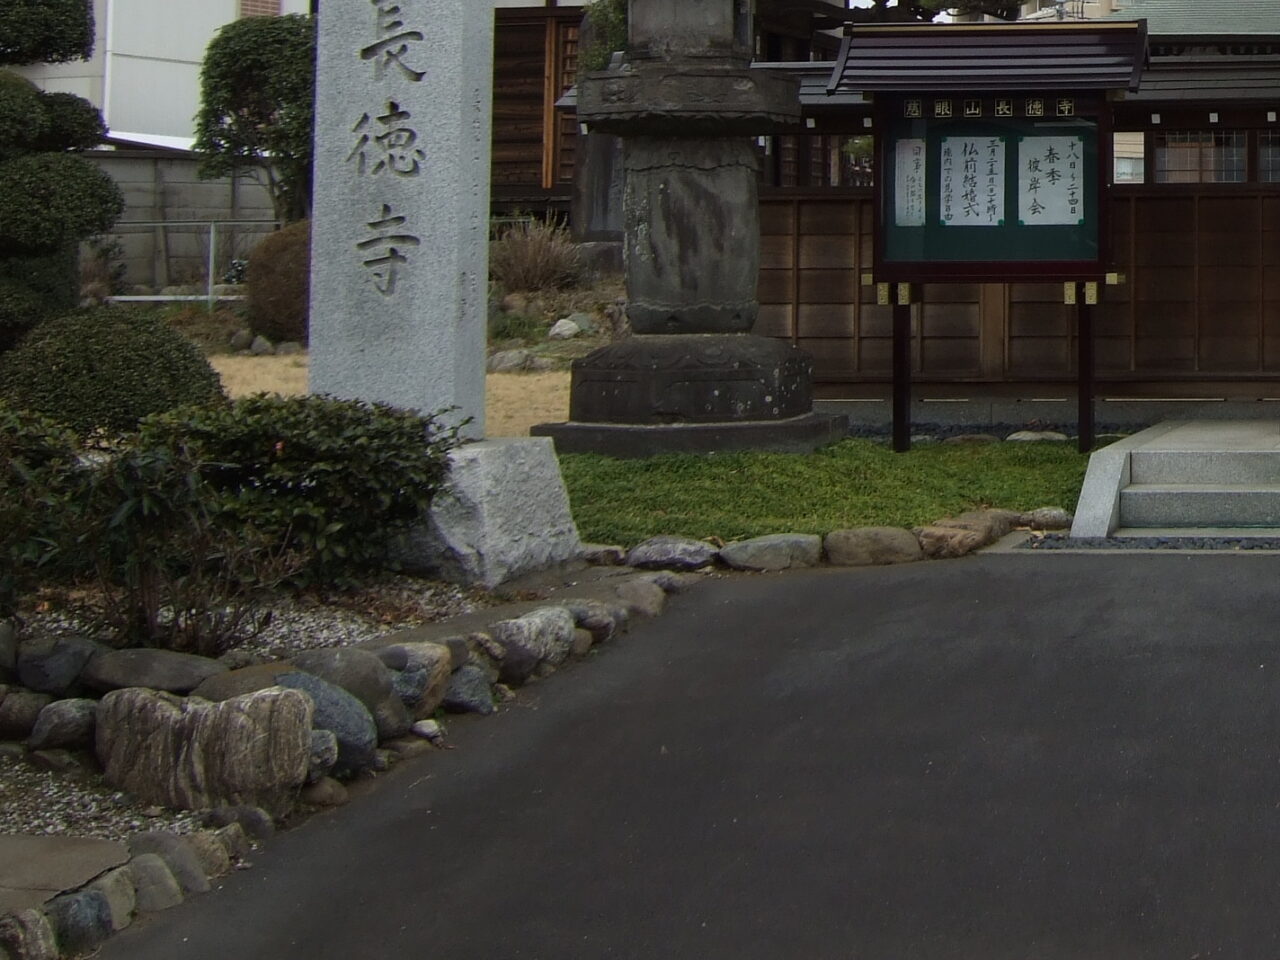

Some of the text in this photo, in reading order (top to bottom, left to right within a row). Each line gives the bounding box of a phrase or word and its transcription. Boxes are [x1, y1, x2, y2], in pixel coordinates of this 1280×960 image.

[905, 99, 1074, 117] 慈眼山長徳寺
[961, 142, 980, 217] 仏前結婚式
[1027, 158, 1046, 216] 彼岸会
